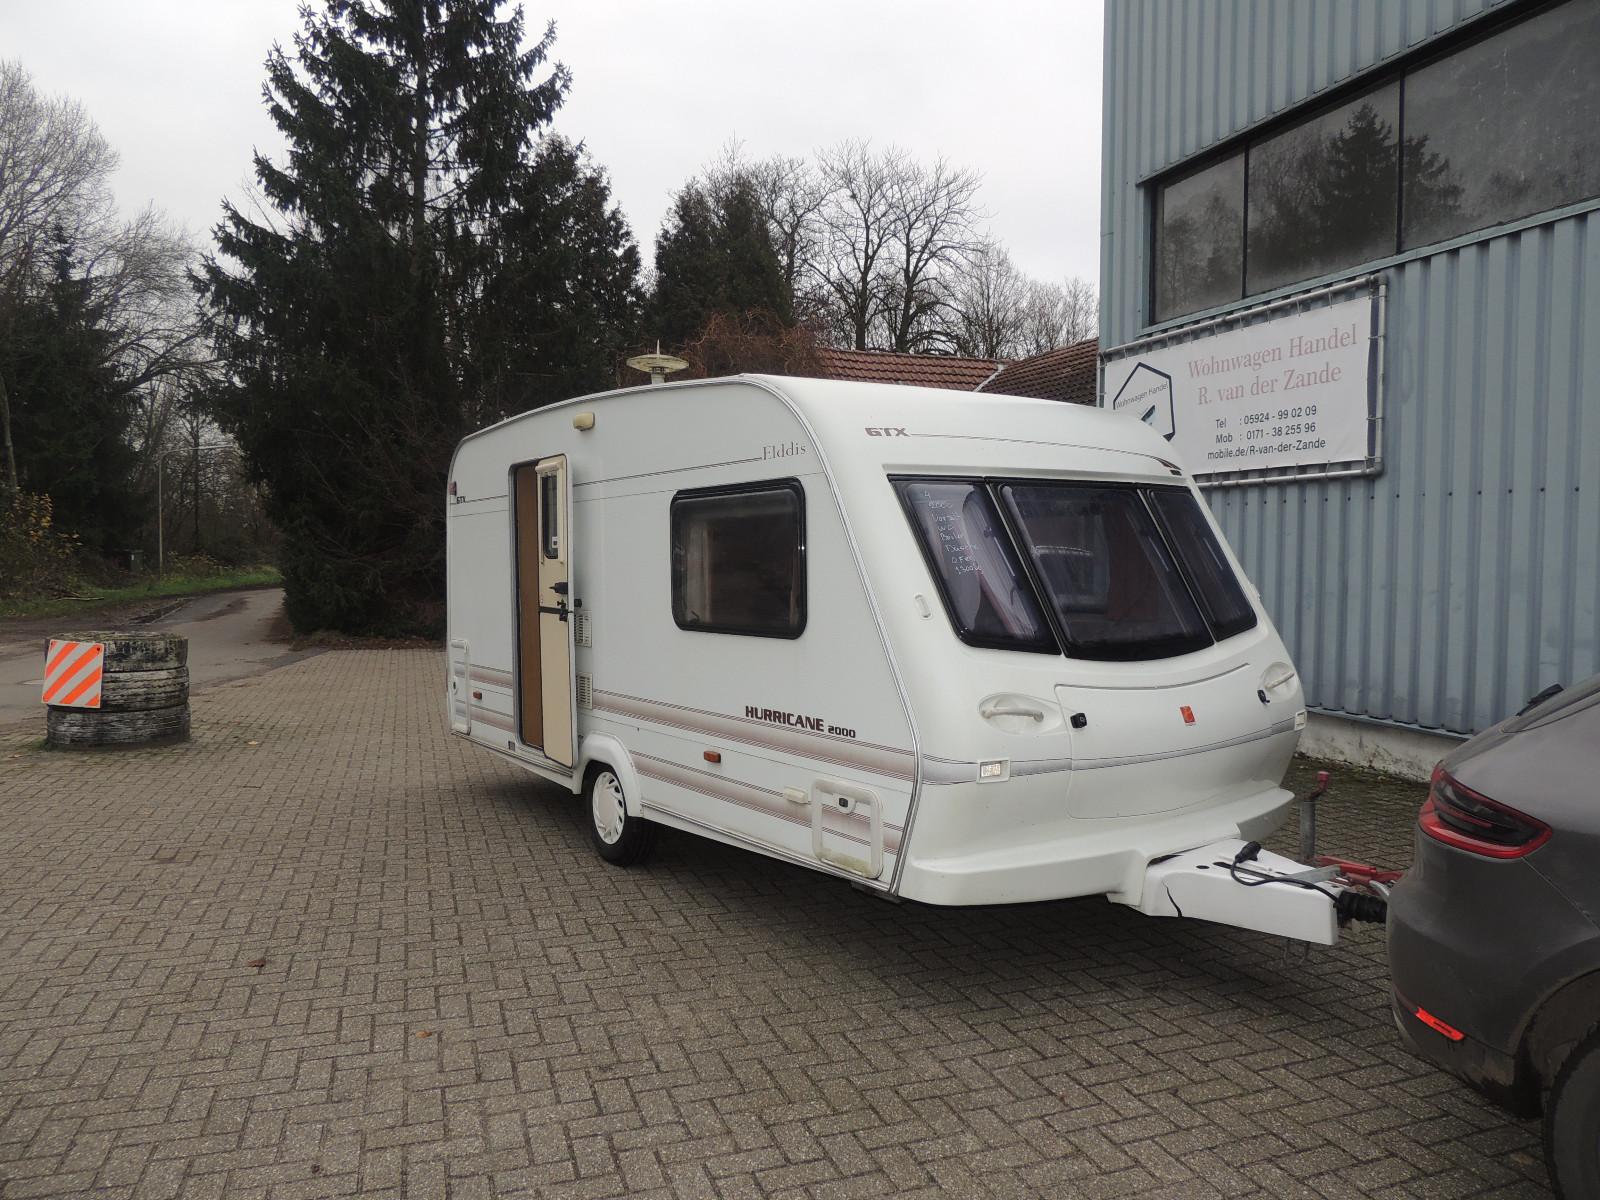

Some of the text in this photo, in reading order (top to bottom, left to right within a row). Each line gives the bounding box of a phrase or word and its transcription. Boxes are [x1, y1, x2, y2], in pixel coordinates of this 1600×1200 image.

[1188, 323, 1357, 378] Wohnwagen Handel
[1198, 362, 1342, 405] R. van der Zande
[1216, 418, 1227, 429] Tel
[1244, 412, 1270, 425] 05924
[1277, 409, 1289, 420] 99
[1291, 407, 1303, 418] 02
[1305, 405, 1317, 416] 09
[864, 427, 911, 437] GTX
[1216, 433, 1233, 444] Mob
[1246, 429, 1264, 440] 0171
[1271, 426, 1283, 437] 38
[1285, 423, 1301, 435] 255
[1304, 422, 1316, 433] 96
[761, 441, 807, 461] Elddis
[745, 705, 856, 738] HURRICANE 2000
